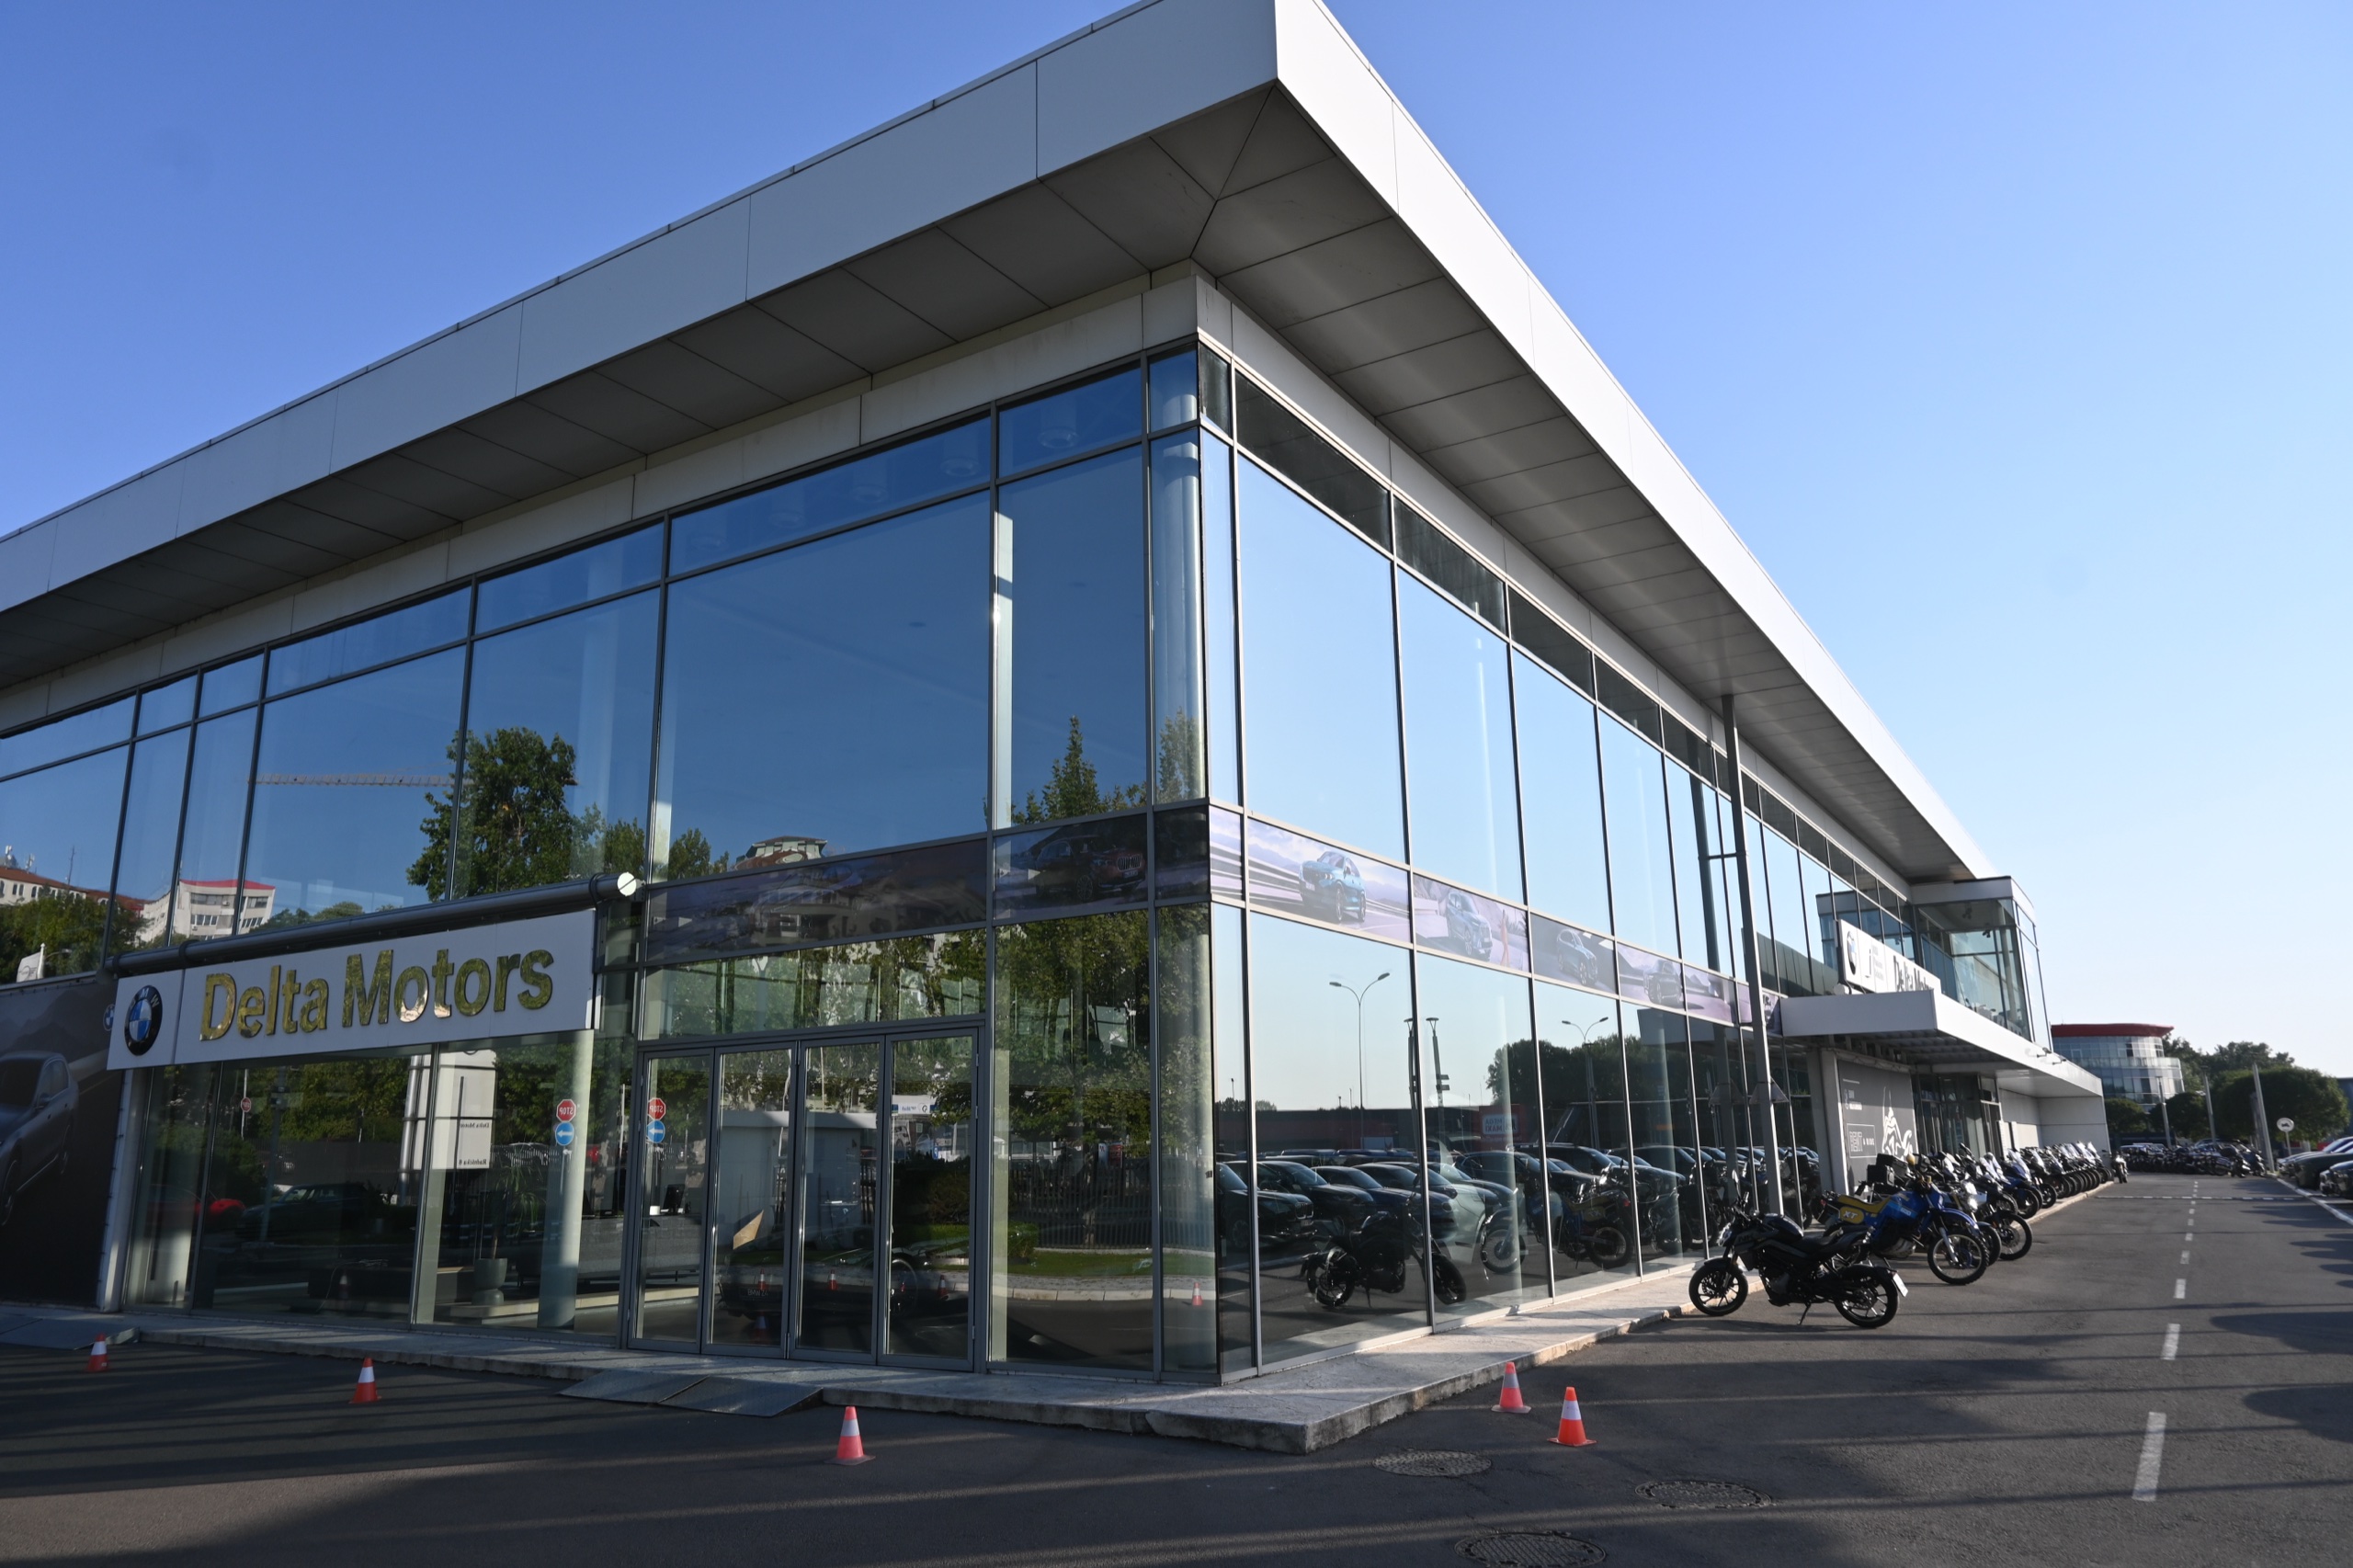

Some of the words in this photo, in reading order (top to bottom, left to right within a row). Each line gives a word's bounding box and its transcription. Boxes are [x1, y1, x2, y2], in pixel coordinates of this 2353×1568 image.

[199, 964, 329, 1041] Delta
[342, 949, 554, 1028] Motors
[1843, 1210, 1858, 1219] XT
